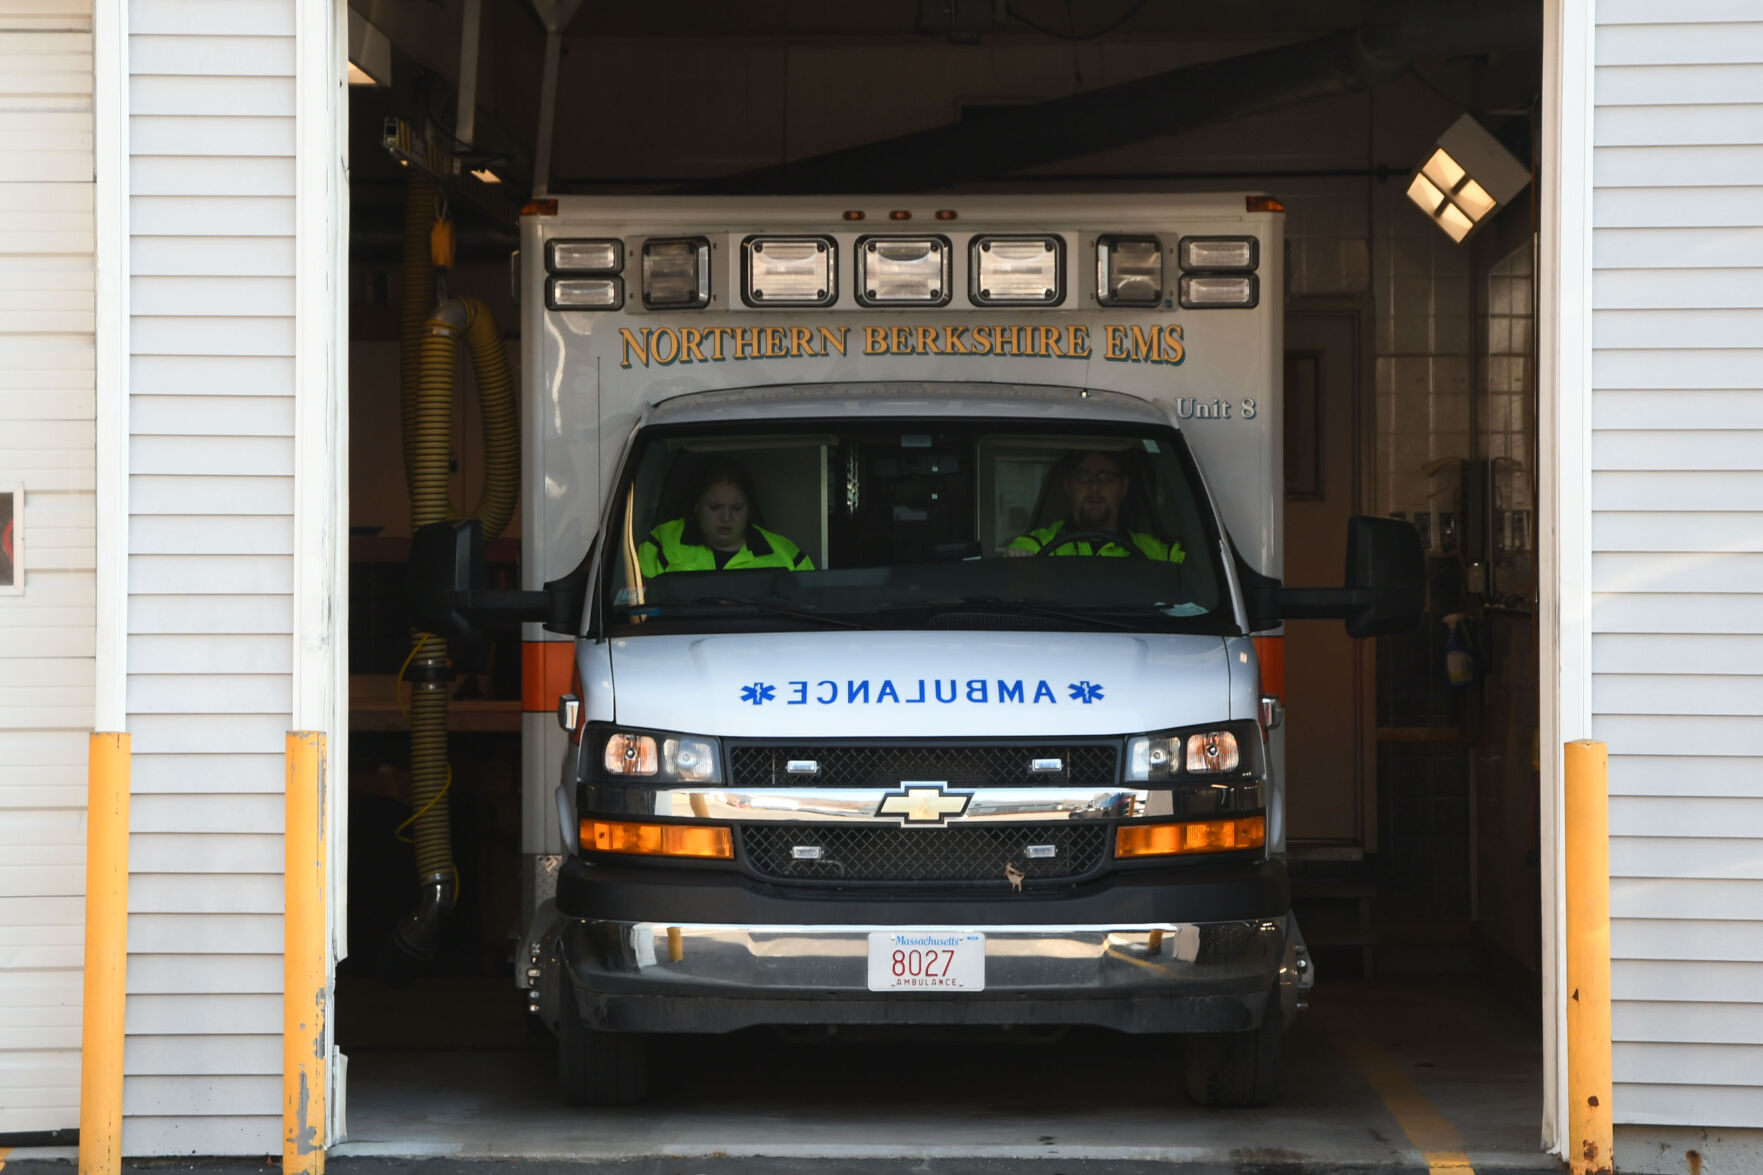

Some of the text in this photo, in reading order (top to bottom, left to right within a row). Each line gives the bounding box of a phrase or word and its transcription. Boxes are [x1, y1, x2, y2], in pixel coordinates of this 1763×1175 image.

[618, 324, 1186, 369] NORTHERN BERKSHIRE EMS
[1175, 397, 1256, 419] Unit 8
[895, 935, 959, 947] Massachusetts
[892, 949, 955, 977] 8027
[896, 978, 957, 987] AMBULANCE
